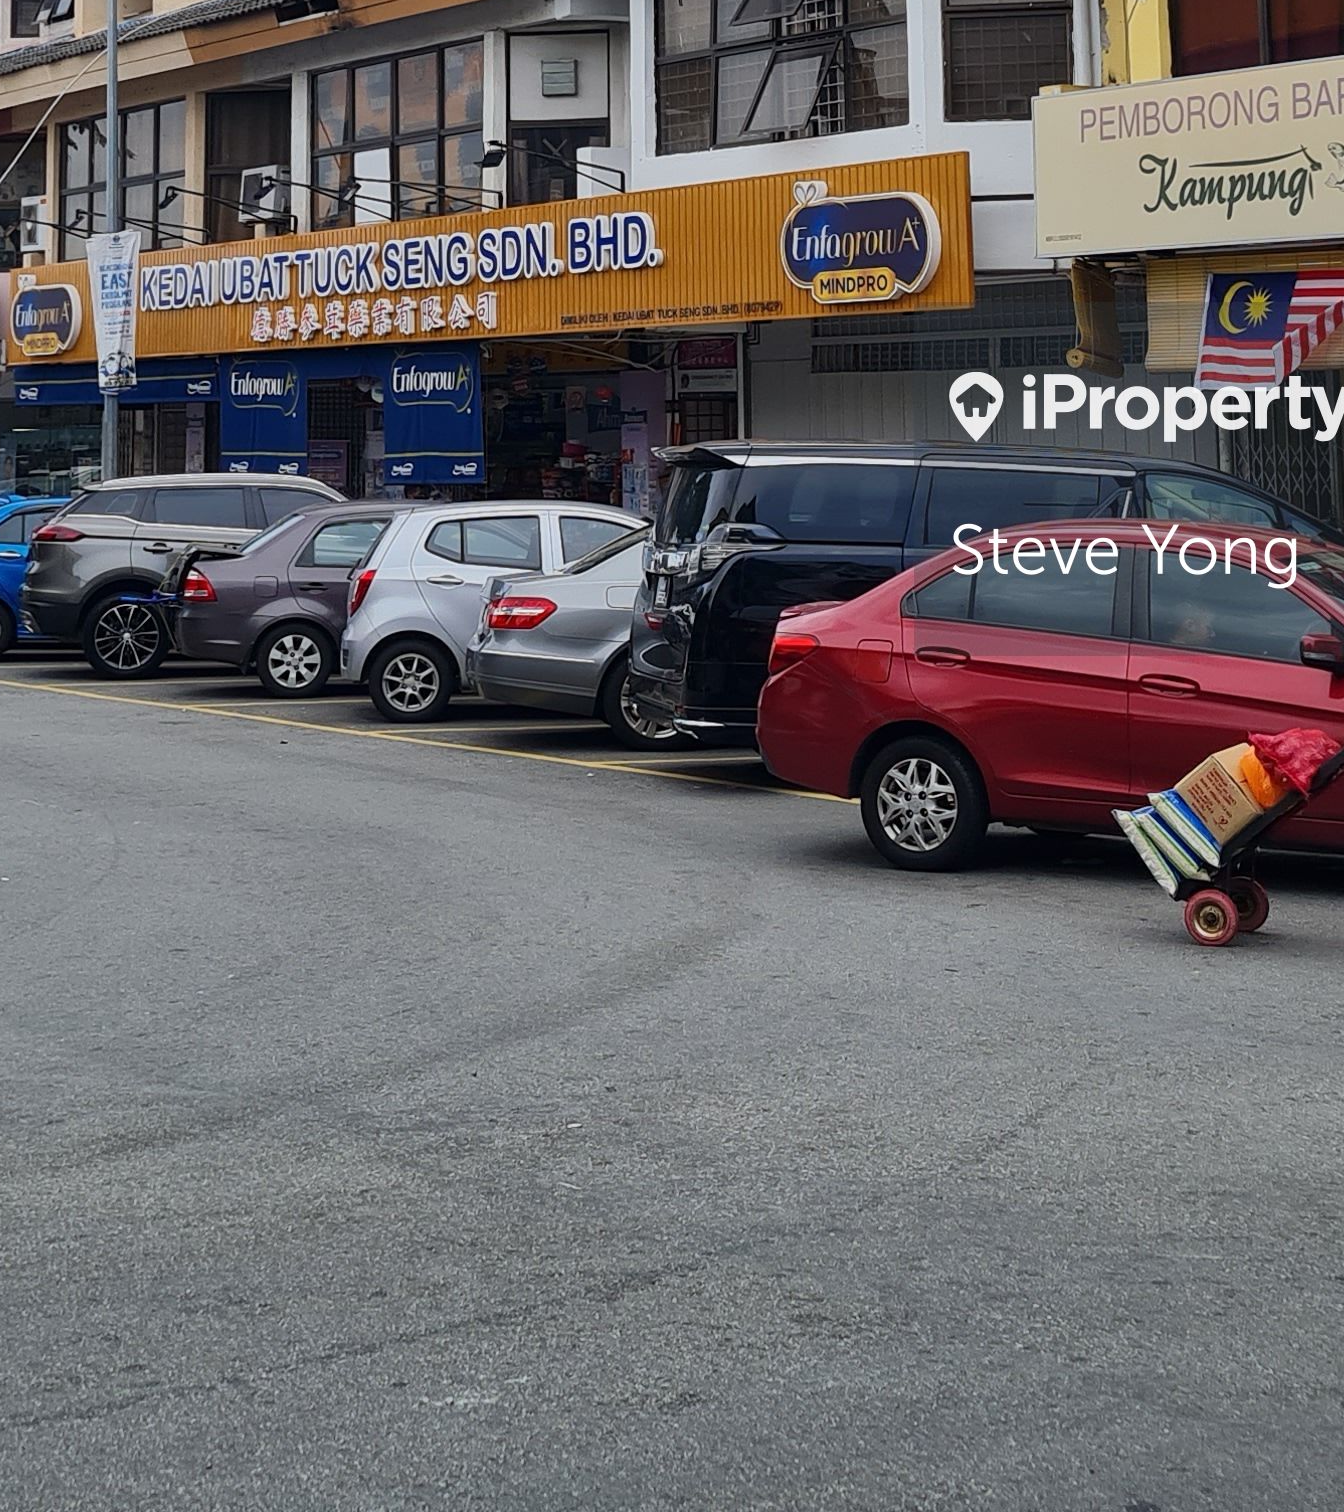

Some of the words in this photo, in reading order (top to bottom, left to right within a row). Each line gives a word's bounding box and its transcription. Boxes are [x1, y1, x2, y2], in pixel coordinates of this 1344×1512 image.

[1080, 88, 1279, 144] PEMBORONG
[1139, 148, 1320, 221] Kampung
[140, 257, 216, 311] KEDAI
[219, 251, 293, 304] UBAT
[294, 242, 380, 298] TUCK
[381, 233, 476, 290] SENG
[478, 222, 564, 283] SDN.
[568, 212, 664, 273] BHD.
[792, 225, 896, 268] Enfagrow
[820, 274, 888, 295] MINDPRO
[16, 304, 58, 332] Enfagrow
[613, 312, 636, 322] KEDAI
[636, 311, 654, 320] UBAT
[658, 309, 679, 319] TUCK
[679, 307, 701, 318] SENG
[231, 371, 284, 402] Enfagrow
[393, 365, 455, 397] Enfagrow
